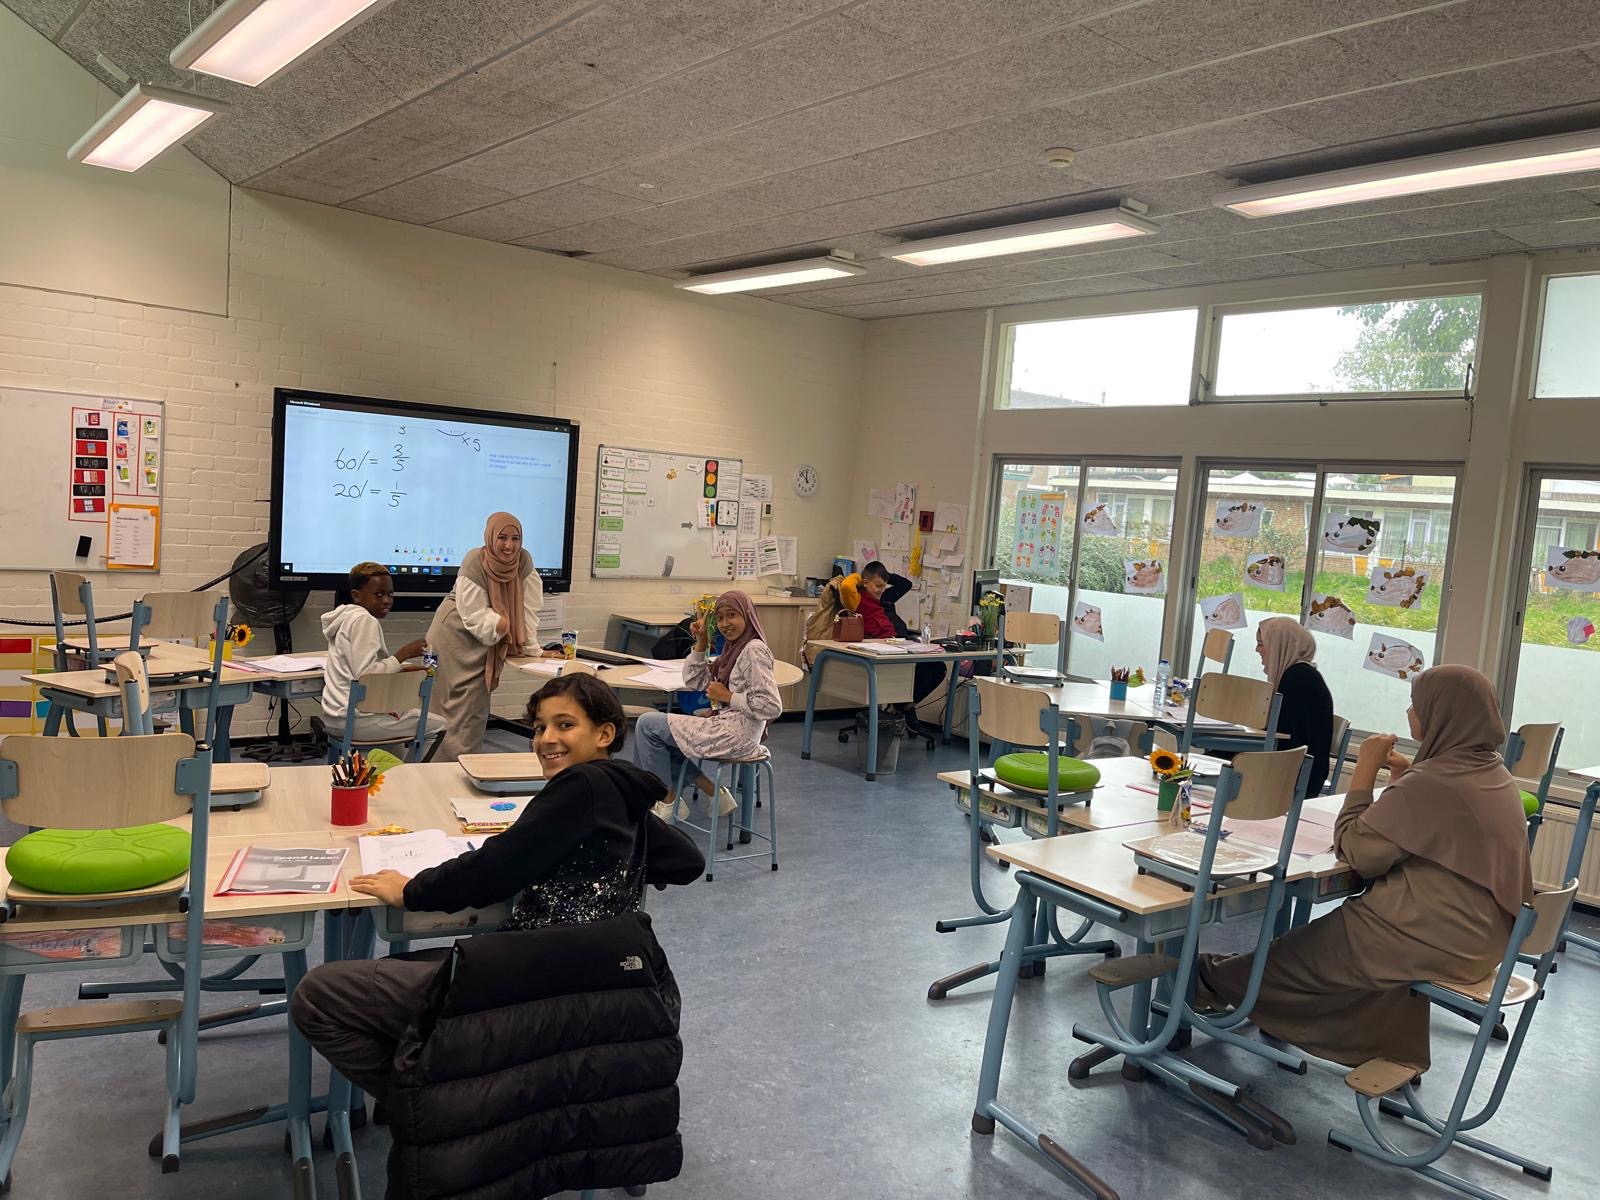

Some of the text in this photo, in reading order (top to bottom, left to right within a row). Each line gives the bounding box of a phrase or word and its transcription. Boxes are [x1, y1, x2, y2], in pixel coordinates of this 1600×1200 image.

[394, 444, 403, 458] 3
[392, 459, 404, 471] 5
[388, 495, 400, 507] 5
